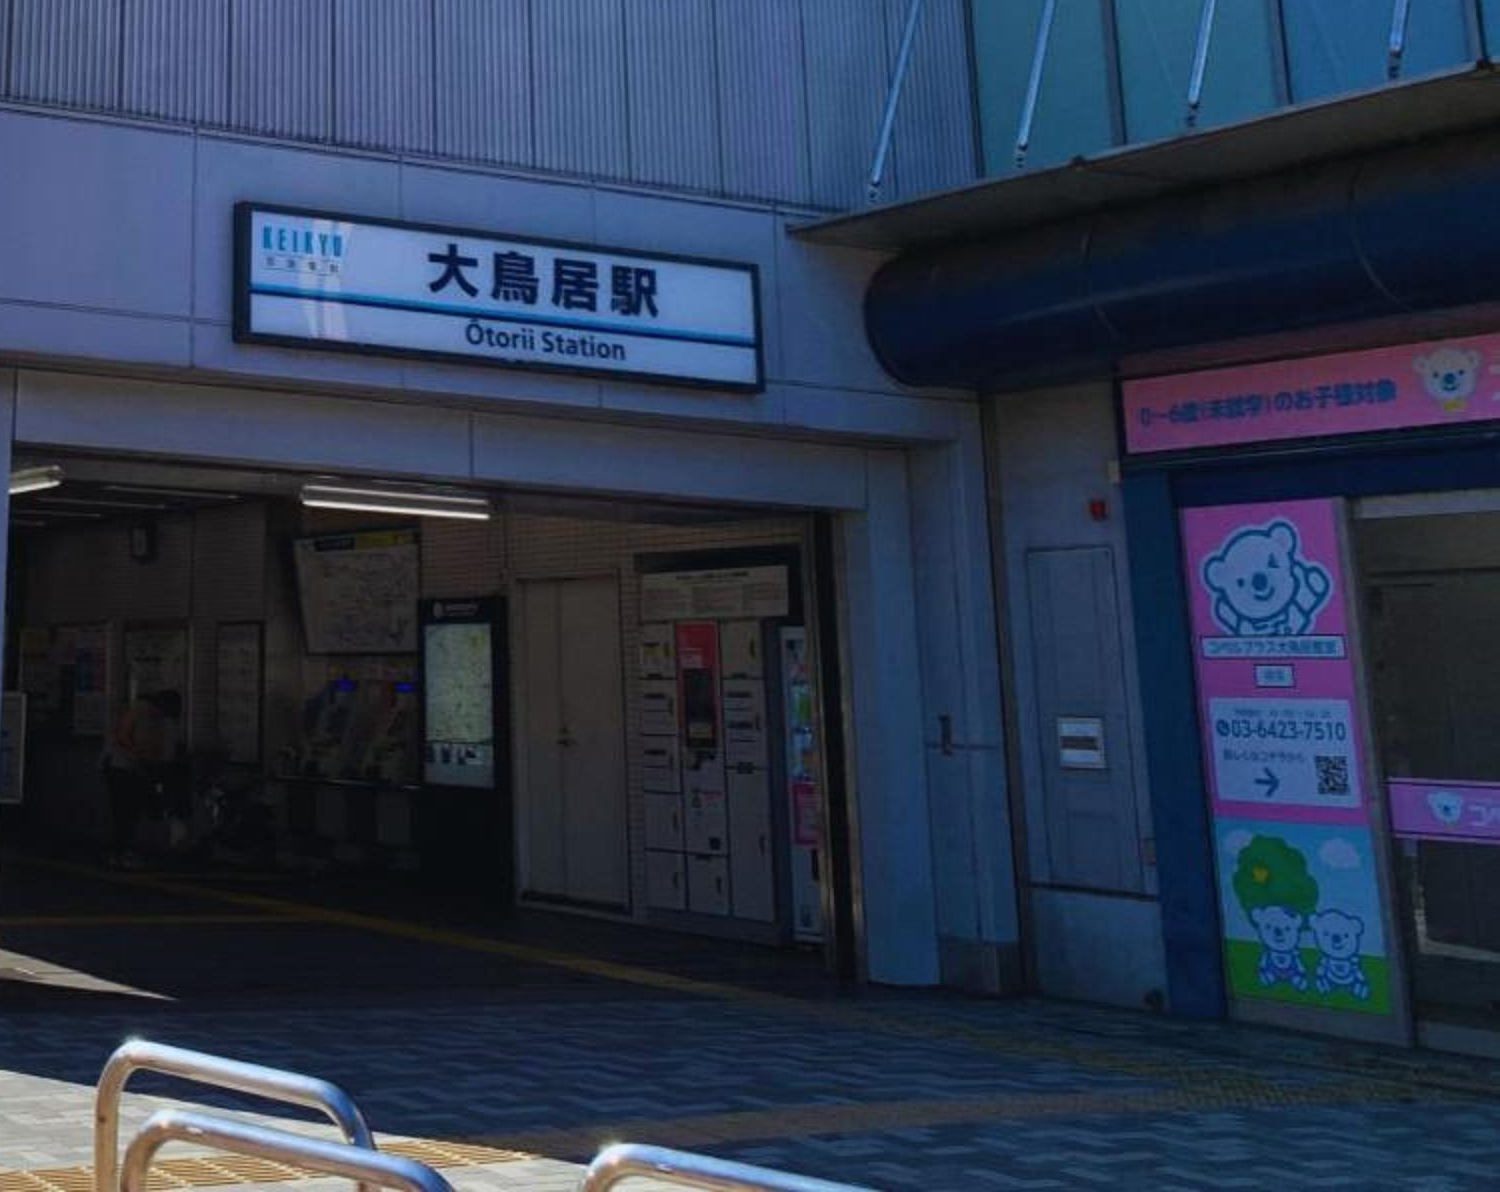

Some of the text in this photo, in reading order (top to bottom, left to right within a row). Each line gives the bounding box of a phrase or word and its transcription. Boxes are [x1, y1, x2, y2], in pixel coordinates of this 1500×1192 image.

[263, 224, 343, 258] KEIKYU
[426, 243, 659, 319] 大鳥居駅
[541, 332, 627, 362] Station
[1231, 719, 1347, 742] 03-6423-7510
